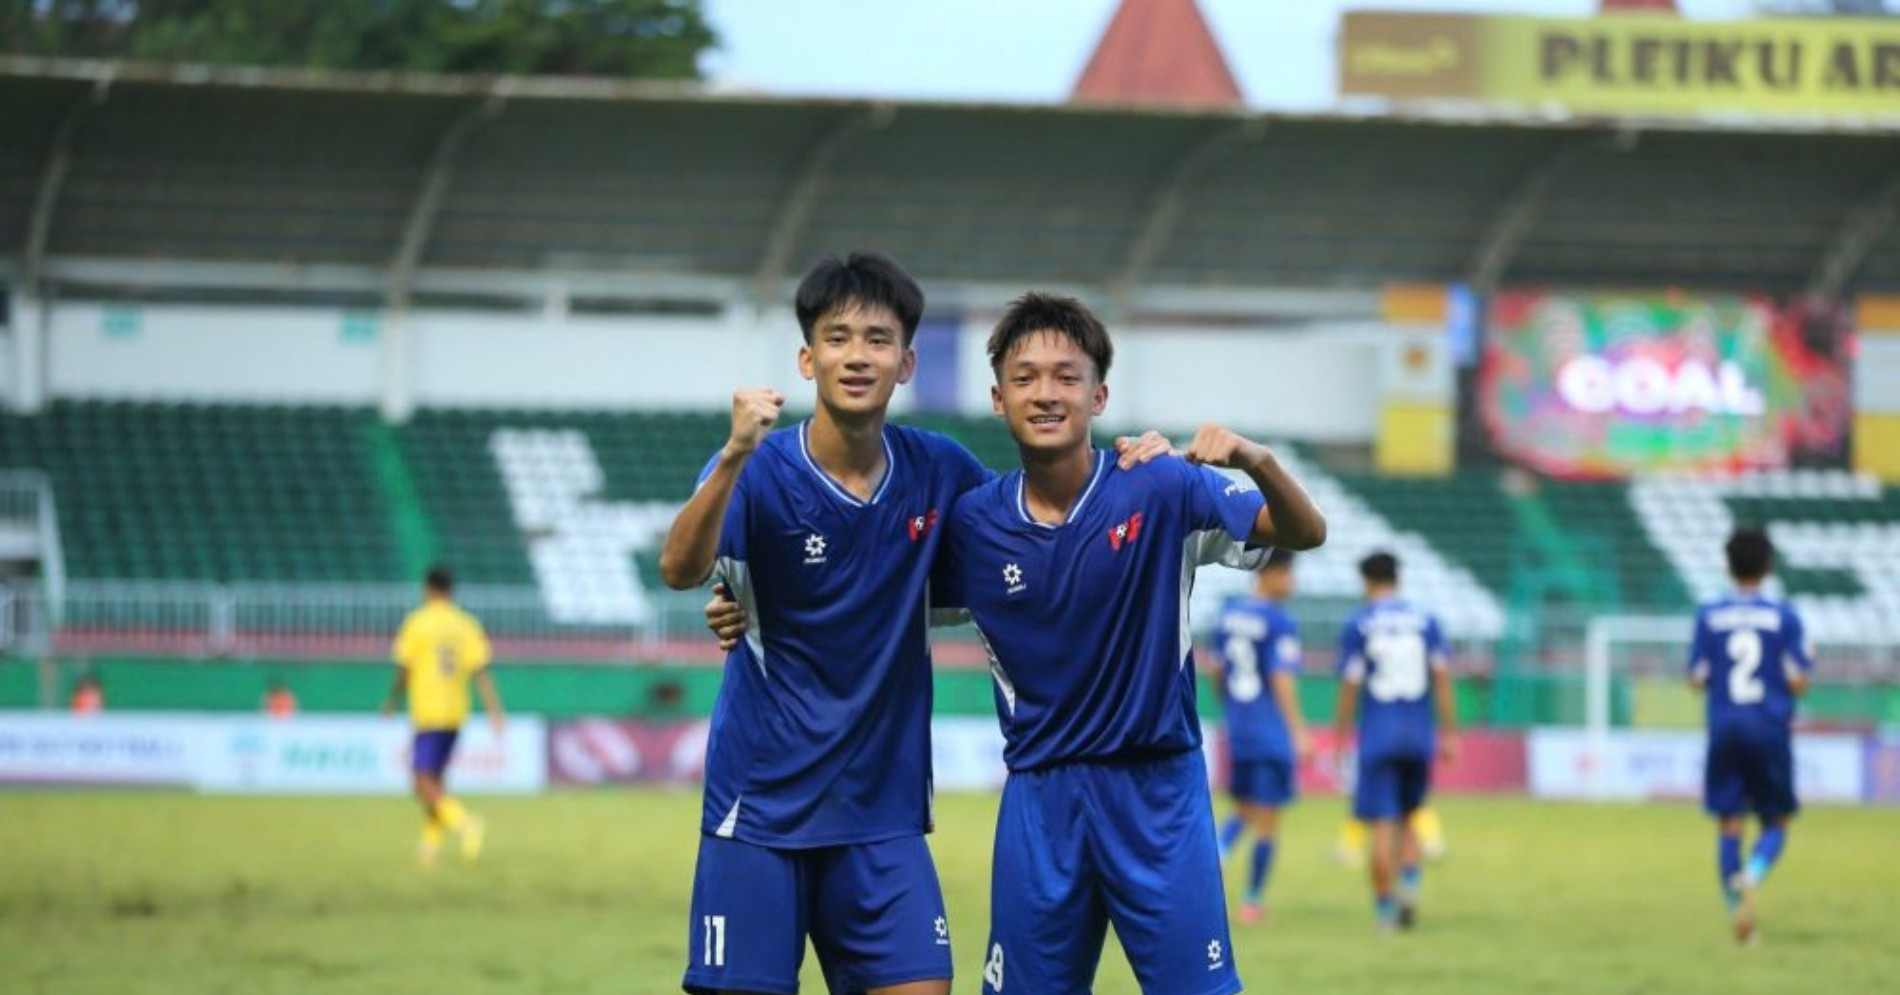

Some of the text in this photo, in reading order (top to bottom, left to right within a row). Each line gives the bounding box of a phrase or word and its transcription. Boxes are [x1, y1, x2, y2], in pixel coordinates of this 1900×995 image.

[1538, 35, 1803, 88] PLEIKU
[1726, 628, 1766, 705] 2
[703, 914, 726, 966] 11
